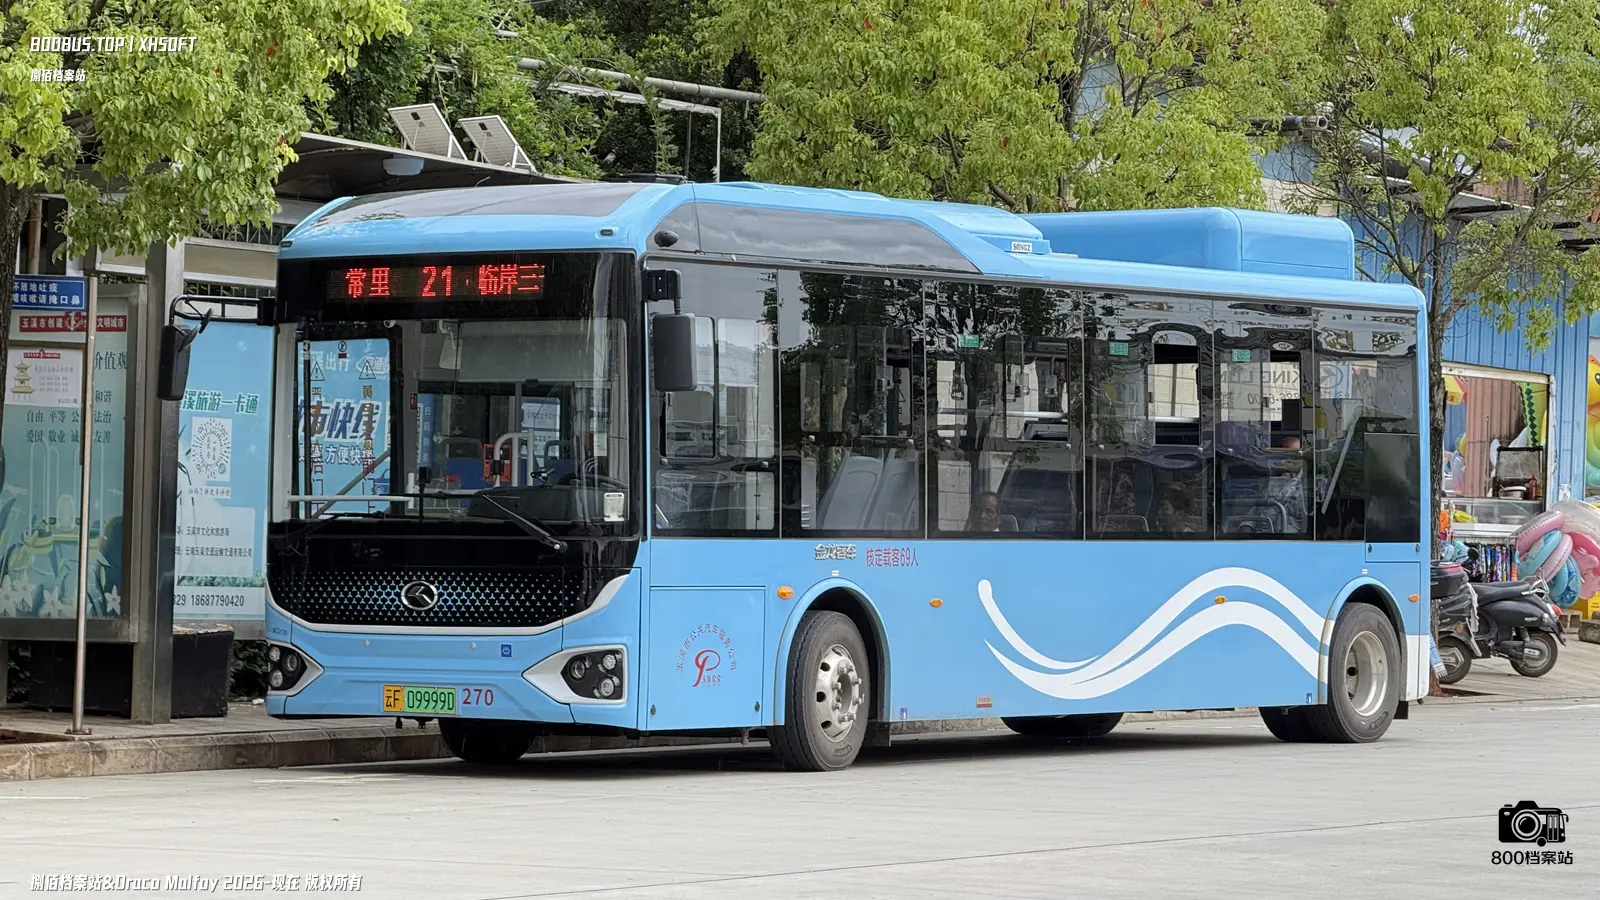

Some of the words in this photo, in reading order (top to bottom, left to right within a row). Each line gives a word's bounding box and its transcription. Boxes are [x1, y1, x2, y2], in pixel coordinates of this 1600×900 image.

[345, 267, 390, 298] 常里
[422, 265, 452, 297] 21
[478, 263, 545, 295] 临岸三
[179, 389, 260, 415] 溪旅游一卡通
[27, 409, 43, 423] 自由
[49, 409, 67, 423] 平等
[25, 429, 43, 444] 爱国
[48, 429, 66, 443] 敬业
[814, 543, 857, 560] 金龙客车
[865, 547, 919, 568] 核定载客69人
[462, 687, 495, 706] 270
